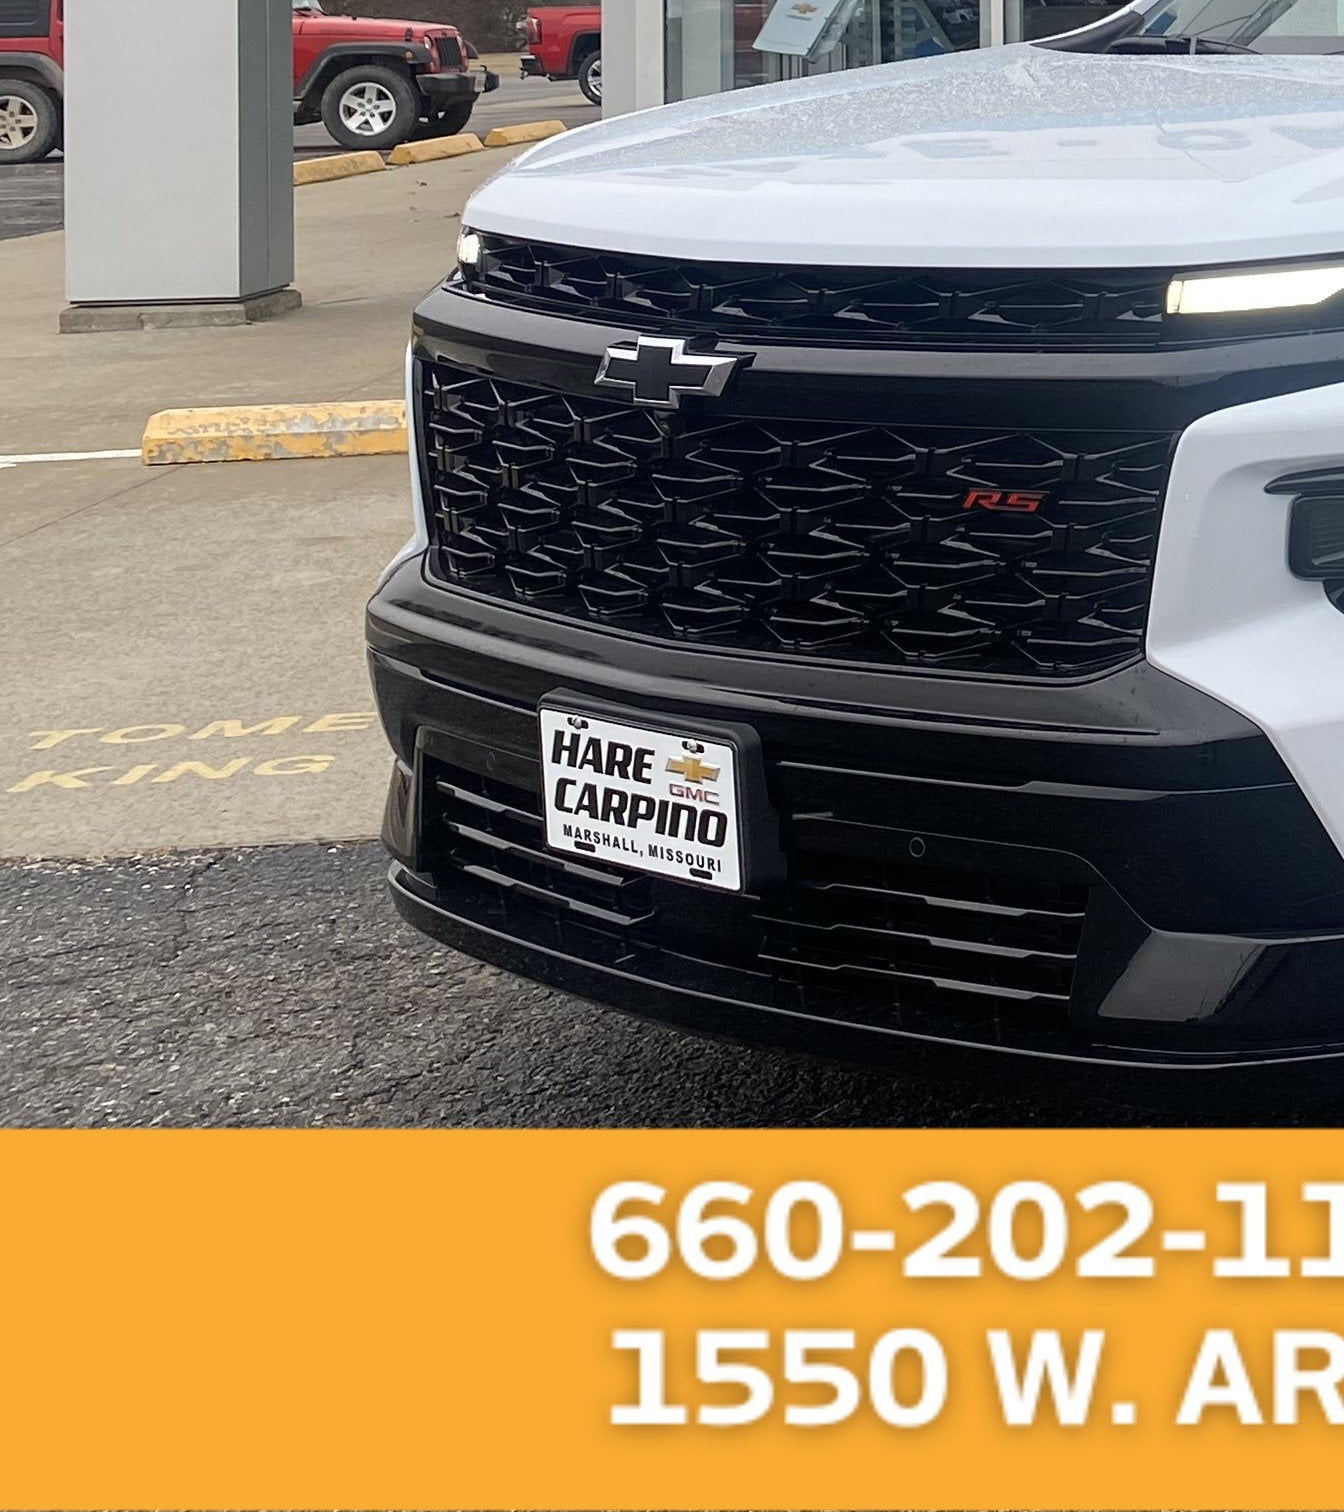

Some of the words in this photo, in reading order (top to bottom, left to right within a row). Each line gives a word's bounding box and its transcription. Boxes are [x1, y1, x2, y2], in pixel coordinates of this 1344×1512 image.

[962, 490, 1044, 513] RS
[551, 728, 656, 785] HARE
[554, 776, 729, 848] CARPINO
[668, 782, 720, 806] GMC
[562, 823, 645, 858] MARSHALL,
[648, 844, 722, 873] MISSOURI
